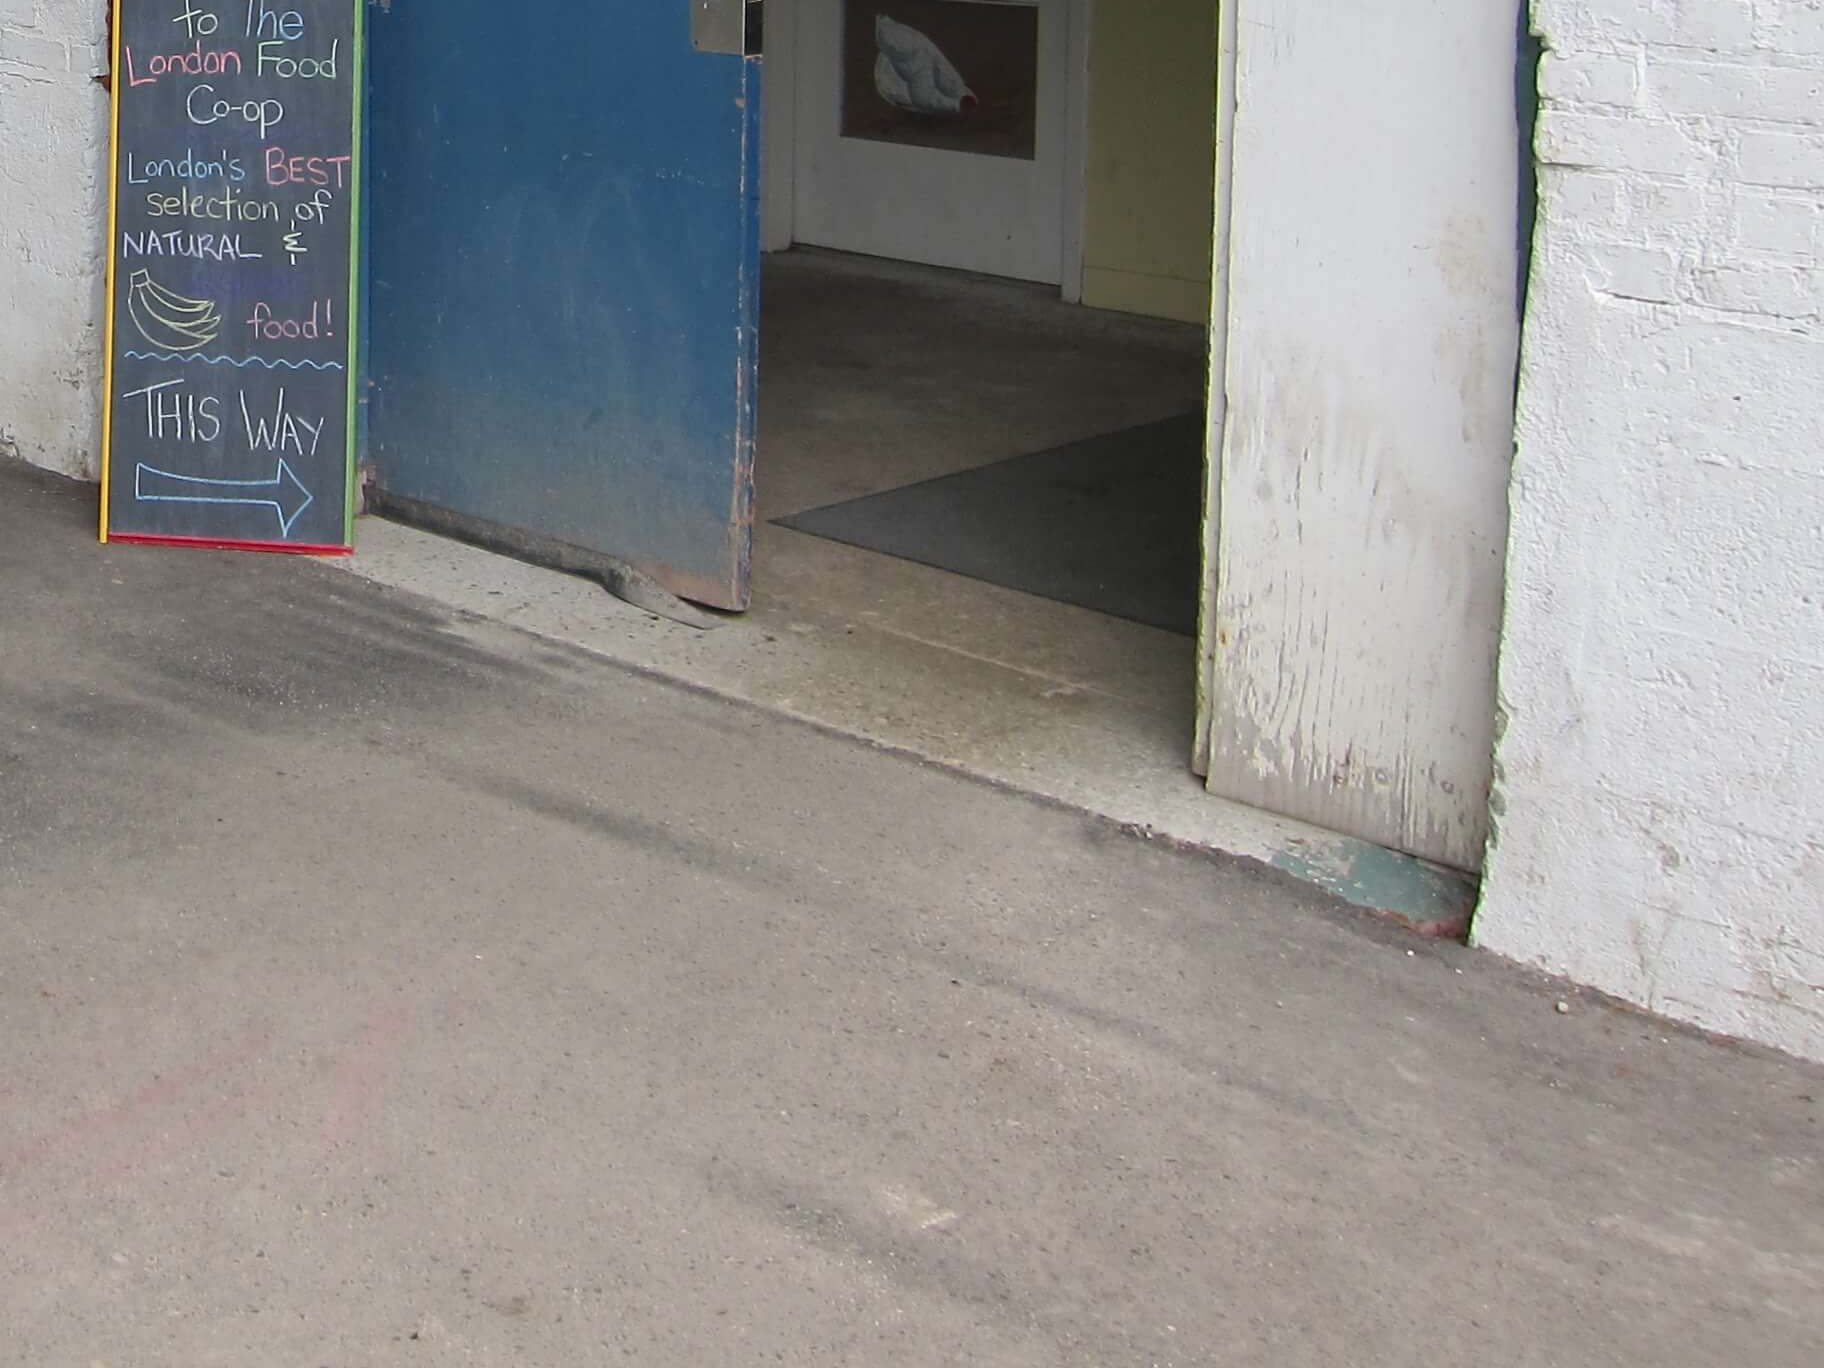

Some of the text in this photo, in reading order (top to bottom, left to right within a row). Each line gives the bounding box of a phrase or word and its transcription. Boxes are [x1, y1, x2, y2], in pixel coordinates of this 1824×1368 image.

[126, 38, 339, 87] London Food
[186, 83, 284, 140] Co-op
[127, 146, 352, 188] London's BEST
[294, 188, 333, 225] of
[123, 230, 263, 261] NATURAL
[246, 298, 334, 339] food!
[122, 378, 324, 456] THIS WAY
